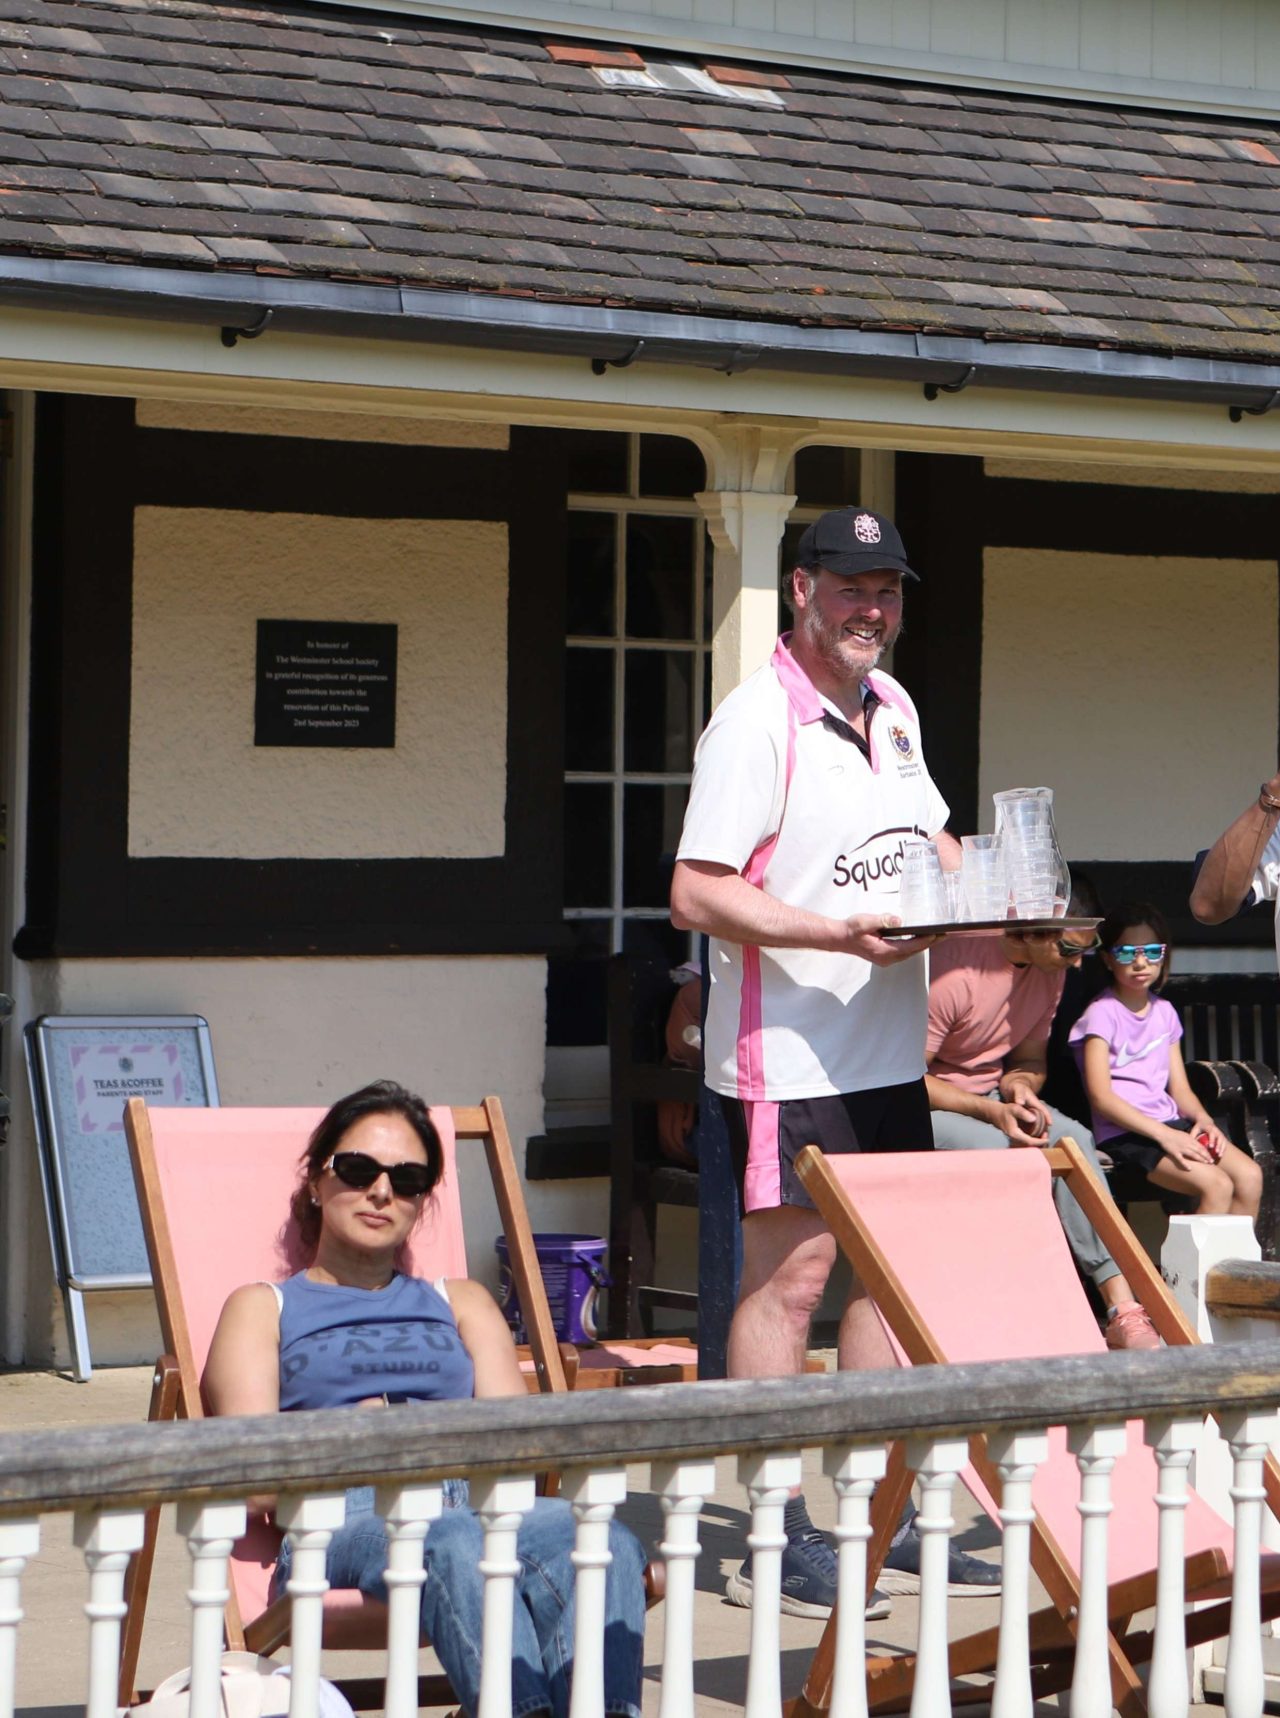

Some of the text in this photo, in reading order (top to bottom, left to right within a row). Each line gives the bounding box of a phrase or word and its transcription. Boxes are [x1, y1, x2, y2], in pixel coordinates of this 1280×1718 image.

[341, 642, 349, 650] of
[276, 655, 289, 663] The
[290, 656, 330, 664] Westminster
[355, 659, 379, 668] Society
[274, 672, 301, 681] grateful
[302, 674, 340, 682] recognition
[358, 675, 388, 683] generous
[286, 688, 328, 697] contribution
[293, 718, 306, 727] 2nd
[307, 720, 343, 729] September
[832, 840, 907, 892] Squad
[93, 1079, 119, 1089] TEAS
[350, 1360, 441, 1375] STUDIO
